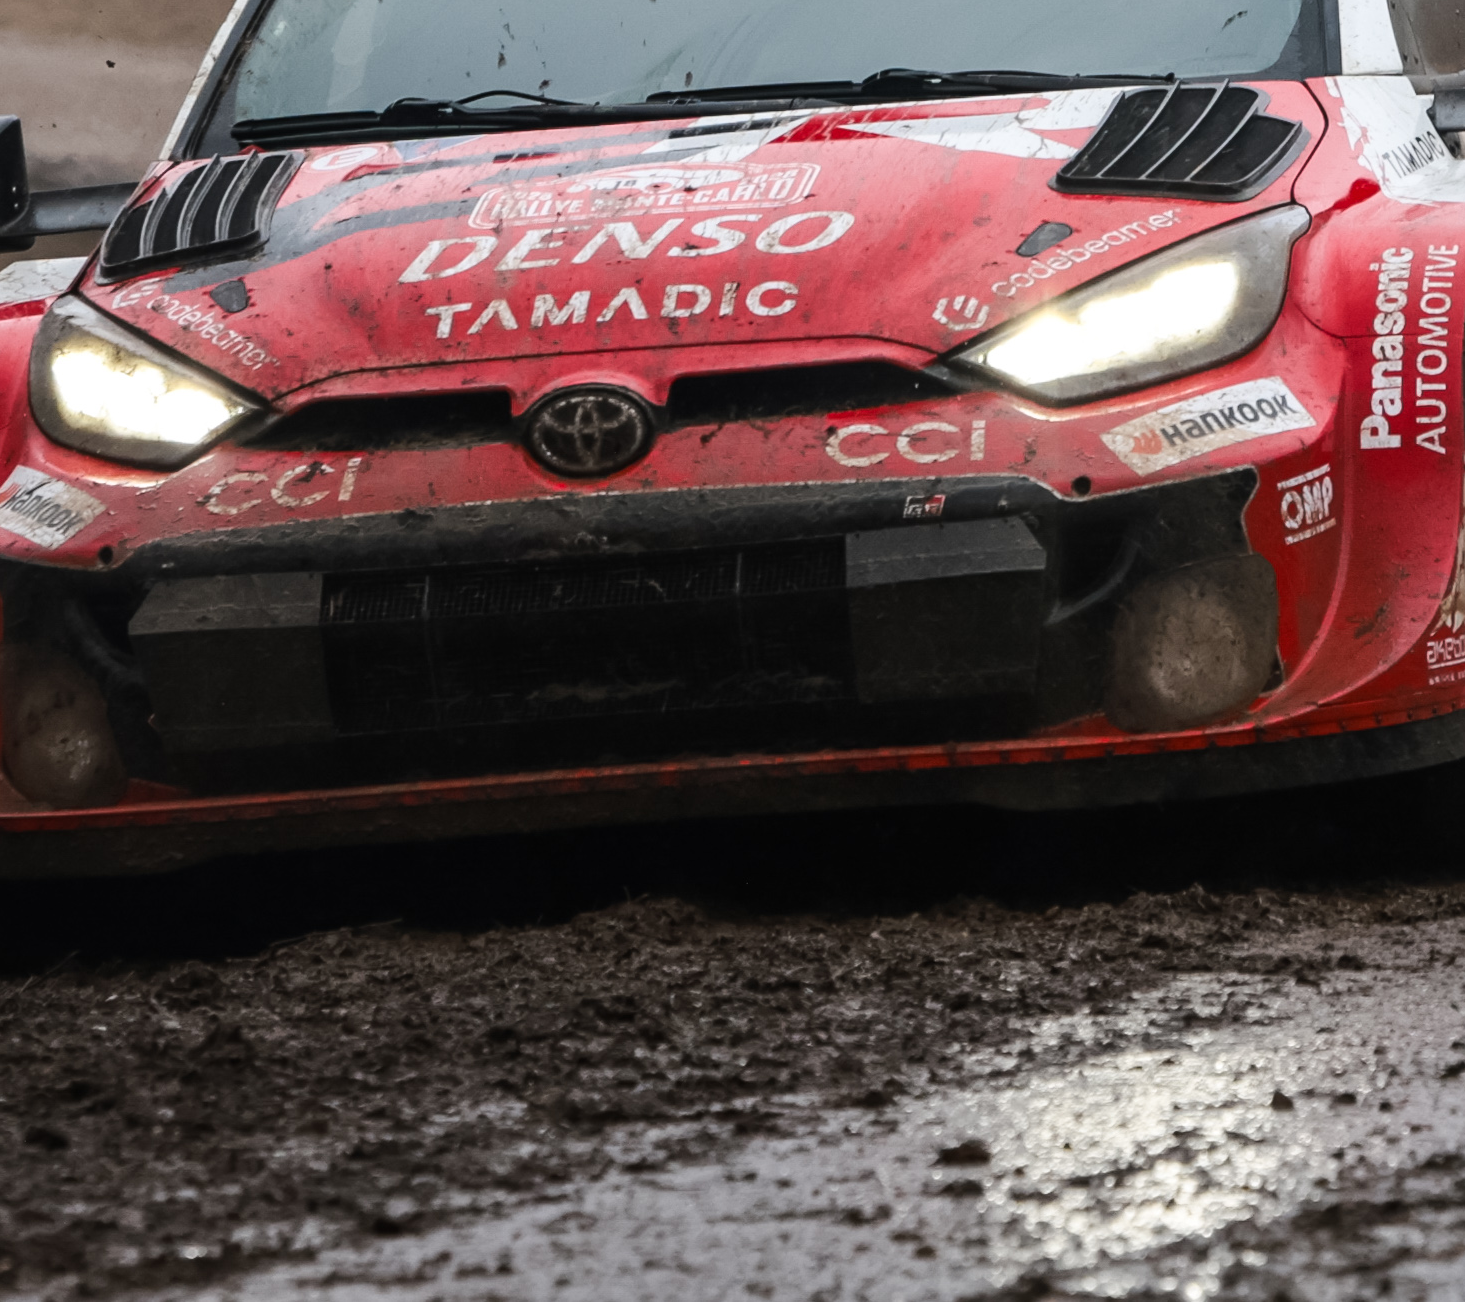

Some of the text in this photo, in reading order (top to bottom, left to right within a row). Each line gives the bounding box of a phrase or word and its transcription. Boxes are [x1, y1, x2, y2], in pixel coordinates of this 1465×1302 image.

[1382, 131, 1445, 179] TAMADIC
[397, 211, 855, 284] DENSO
[991, 207, 1182, 297] codebeamer
[425, 281, 799, 339] TAMADIC
[1360, 246, 1415, 450] Panasonic
[1415, 244, 1459, 454] AUTOMOTIVE
[825, 420, 986, 467] CCI
[206, 457, 362, 515] CCI
[1280, 476, 1333, 530] OMP
